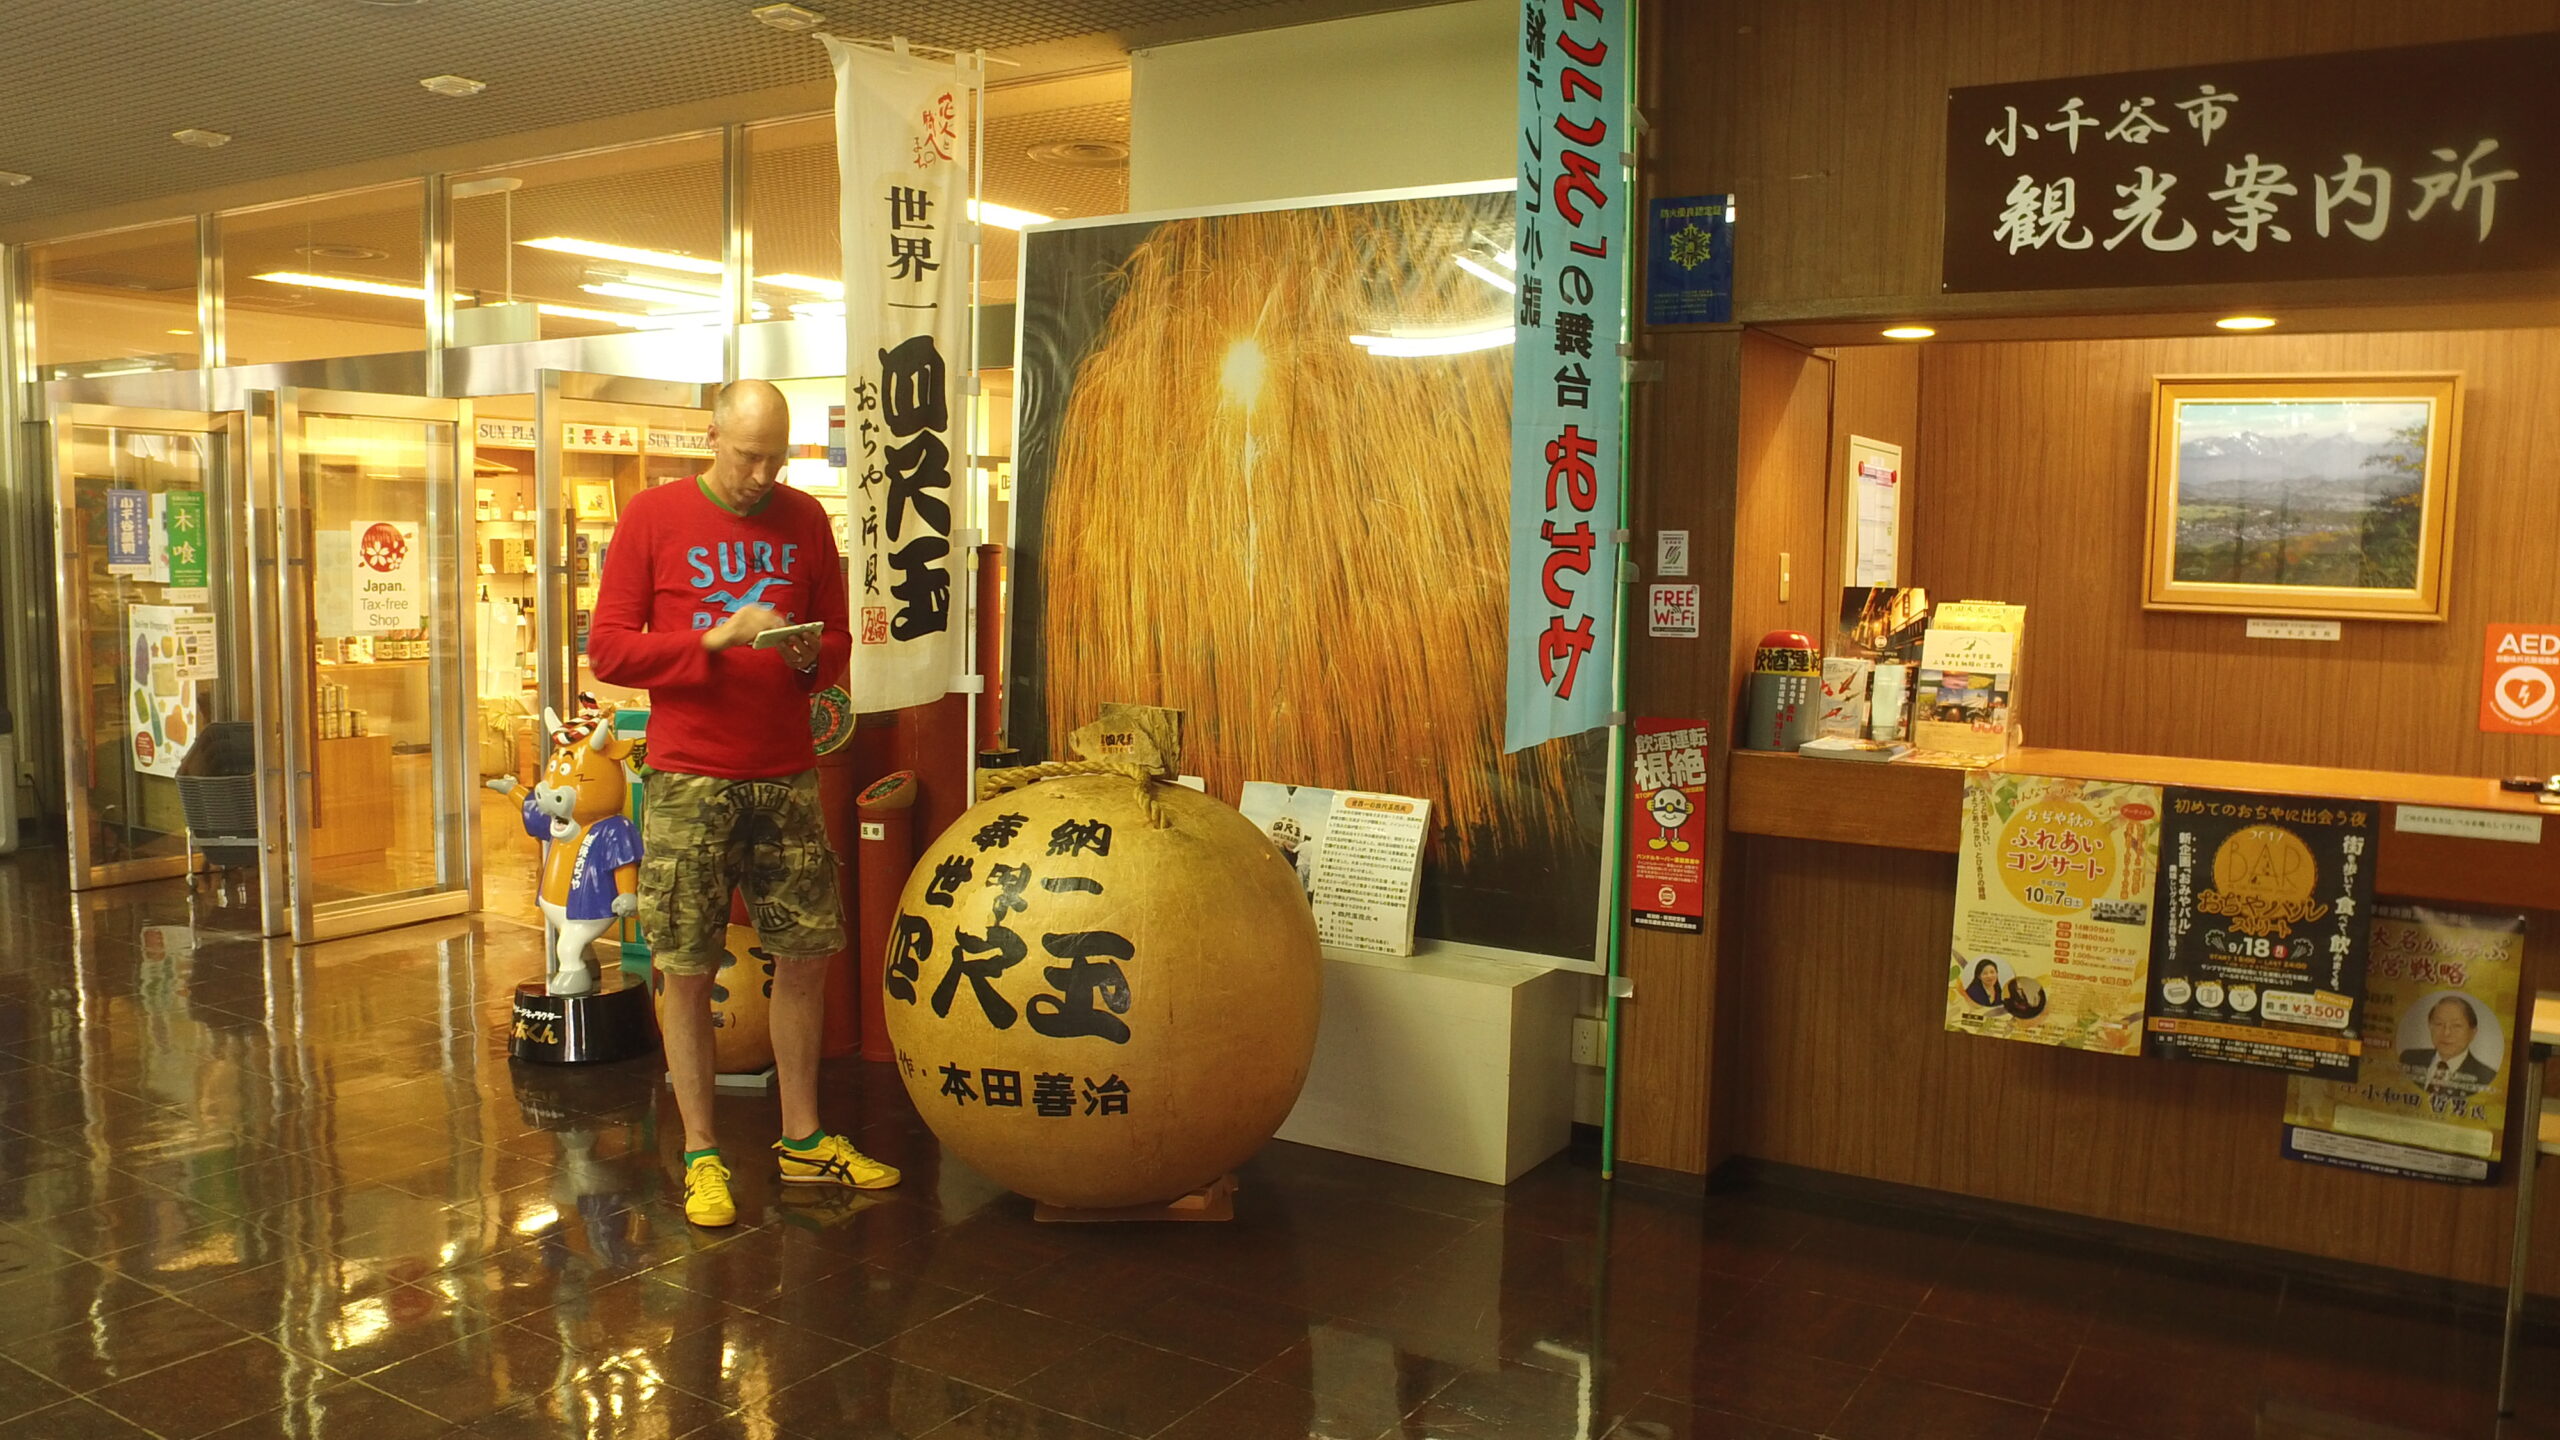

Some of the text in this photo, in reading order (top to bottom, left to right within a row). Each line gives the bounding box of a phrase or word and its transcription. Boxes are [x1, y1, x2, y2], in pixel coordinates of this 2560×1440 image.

[1986, 84, 2238, 156] 小千谷市
[1993, 139, 2519, 255] 観光案内所
[879, 186, 951, 642] 世界一 四尺玉
[480, 424, 505, 439] SUN
[648, 432, 670, 448] SUN
[687, 541, 798, 588] SURF
[363, 579, 406, 594] Japan.
[1654, 590, 1695, 607] FREE
[360, 598, 408, 610] Tax-free
[1654, 609, 1695, 626] Wi-Fi
[369, 614, 400, 628] Shop
[2497, 632, 2560, 655] AED
[1635, 727, 1708, 754] 飲酒運転
[1634, 748, 1706, 792] 根絶
[2174, 799, 2368, 828] 初めてのおぢやに出会う夜
[2010, 827, 2104, 855] ふれあい
[2006, 852, 2105, 880] コンサート
[926, 855, 1103, 920] 世界一
[2228, 937, 2270, 957] 9/18
[886, 908, 1135, 1045] 四尺玉
